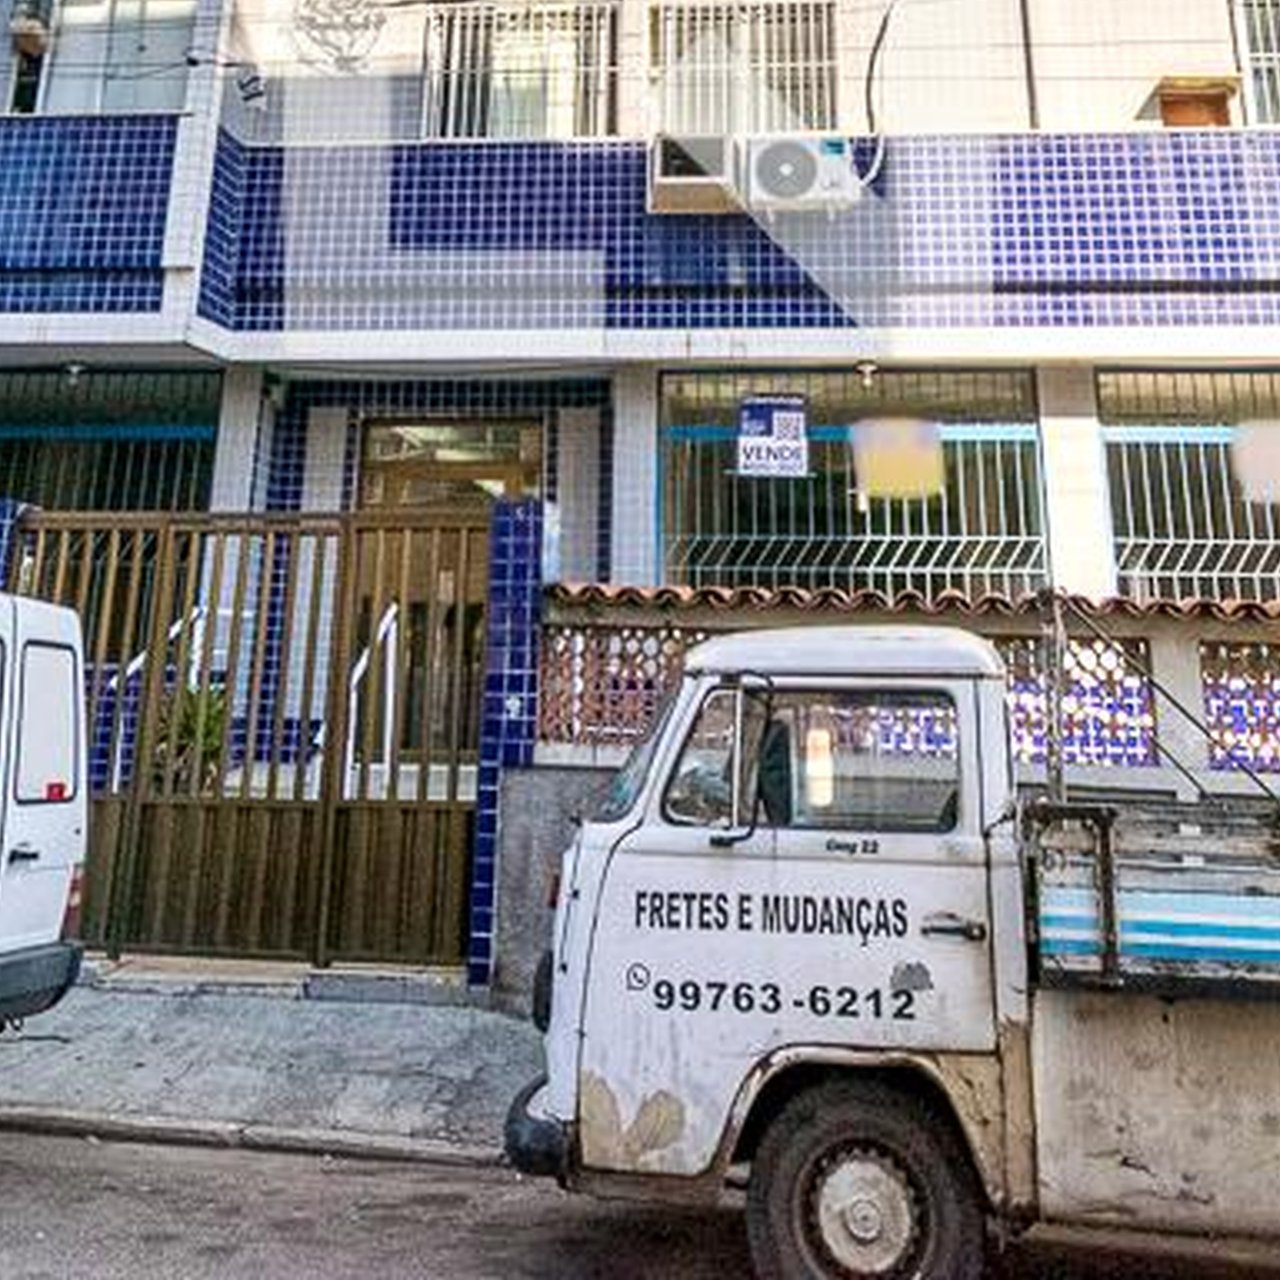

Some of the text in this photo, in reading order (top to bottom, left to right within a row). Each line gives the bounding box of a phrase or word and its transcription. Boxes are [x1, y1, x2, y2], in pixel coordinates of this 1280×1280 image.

[635, 891, 908, 947] FRETES E MUDANÇAS
